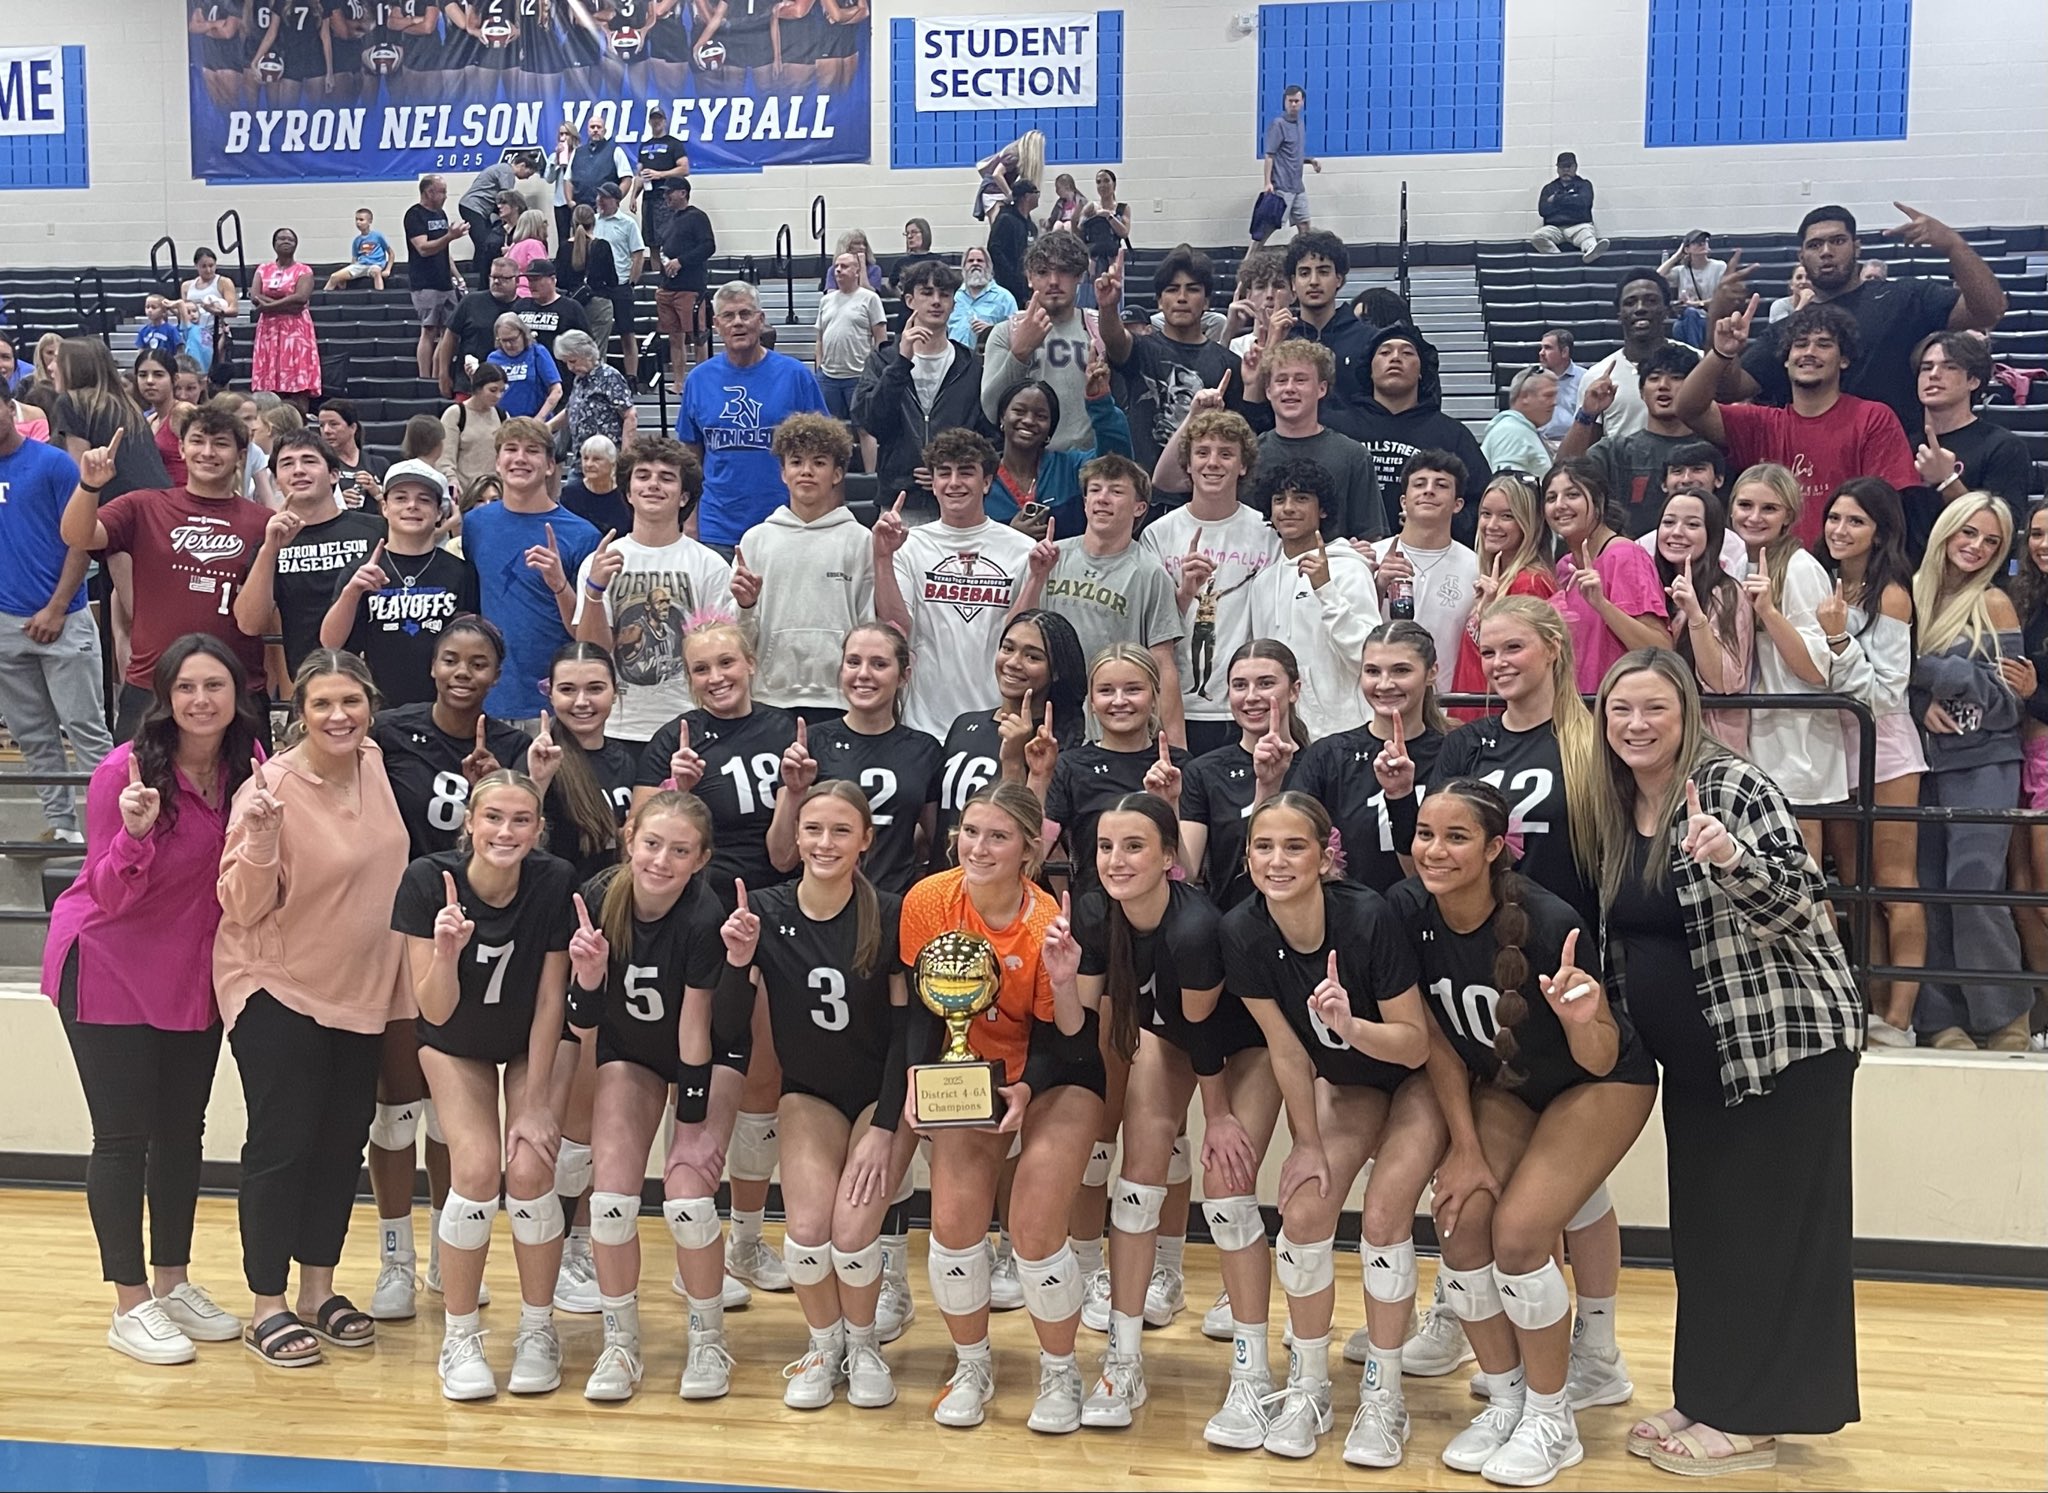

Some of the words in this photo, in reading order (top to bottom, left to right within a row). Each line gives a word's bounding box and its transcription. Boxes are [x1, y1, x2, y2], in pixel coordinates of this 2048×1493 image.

[258, 7, 270, 28] 6
[294, 7, 309, 30] 7
[924, 26, 1090, 59] STUDENT
[930, 66, 1081, 98] SECTION
[224, 108, 367, 154] BYRON
[378, 101, 544, 150] NELSON
[562, 94, 835, 144] VOLLEYBALL
[436, 152, 483, 168] 2025
[1031, 338, 1088, 374] CU
[170, 525, 245, 558] Texas
[278, 544, 318, 560] BYRON
[318, 539, 368, 556] NELSON
[367, 592, 458, 623] PLAYOFFS
[924, 583, 1010, 605] BASEBALL
[1046, 579, 1128, 617] BAYLOR
[720, 752, 781, 815] 18
[859, 767, 898, 826] 2
[941, 751, 998, 811] 16
[427, 770, 469, 831] 8
[1479, 768, 1553, 834] 2
[476, 939, 515, 1004] 7
[624, 964, 664, 1021] 5
[807, 966, 850, 1031] 3
[1429, 977, 1501, 1049] 10
[921, 1090, 957, 1100] District
[943, 1075, 964, 1086] 2025
[928, 1102, 982, 1113] Champions
